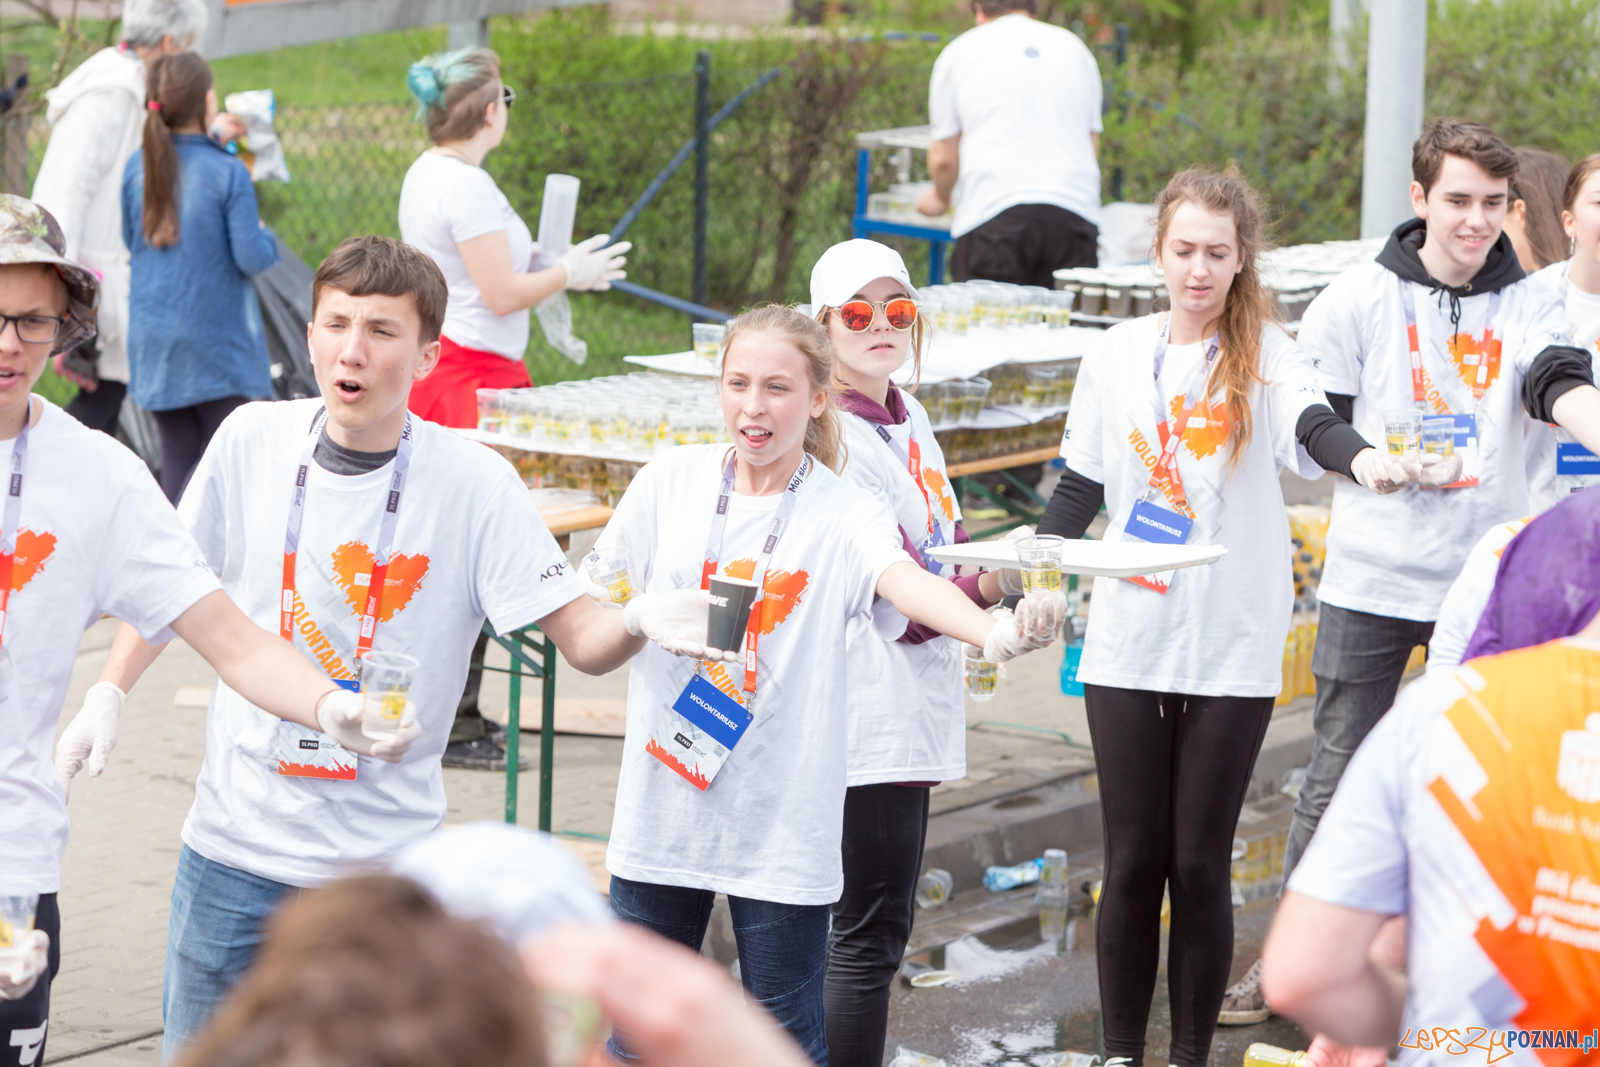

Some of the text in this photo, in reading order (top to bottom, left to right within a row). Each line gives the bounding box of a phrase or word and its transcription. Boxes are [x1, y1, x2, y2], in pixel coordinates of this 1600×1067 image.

[788, 475, 803, 493] Mój
[1136, 514, 1182, 538] WOLONTARIUSZ
[540, 559, 569, 582] AQU
[689, 692, 739, 731] WOLONTARIUSZ
